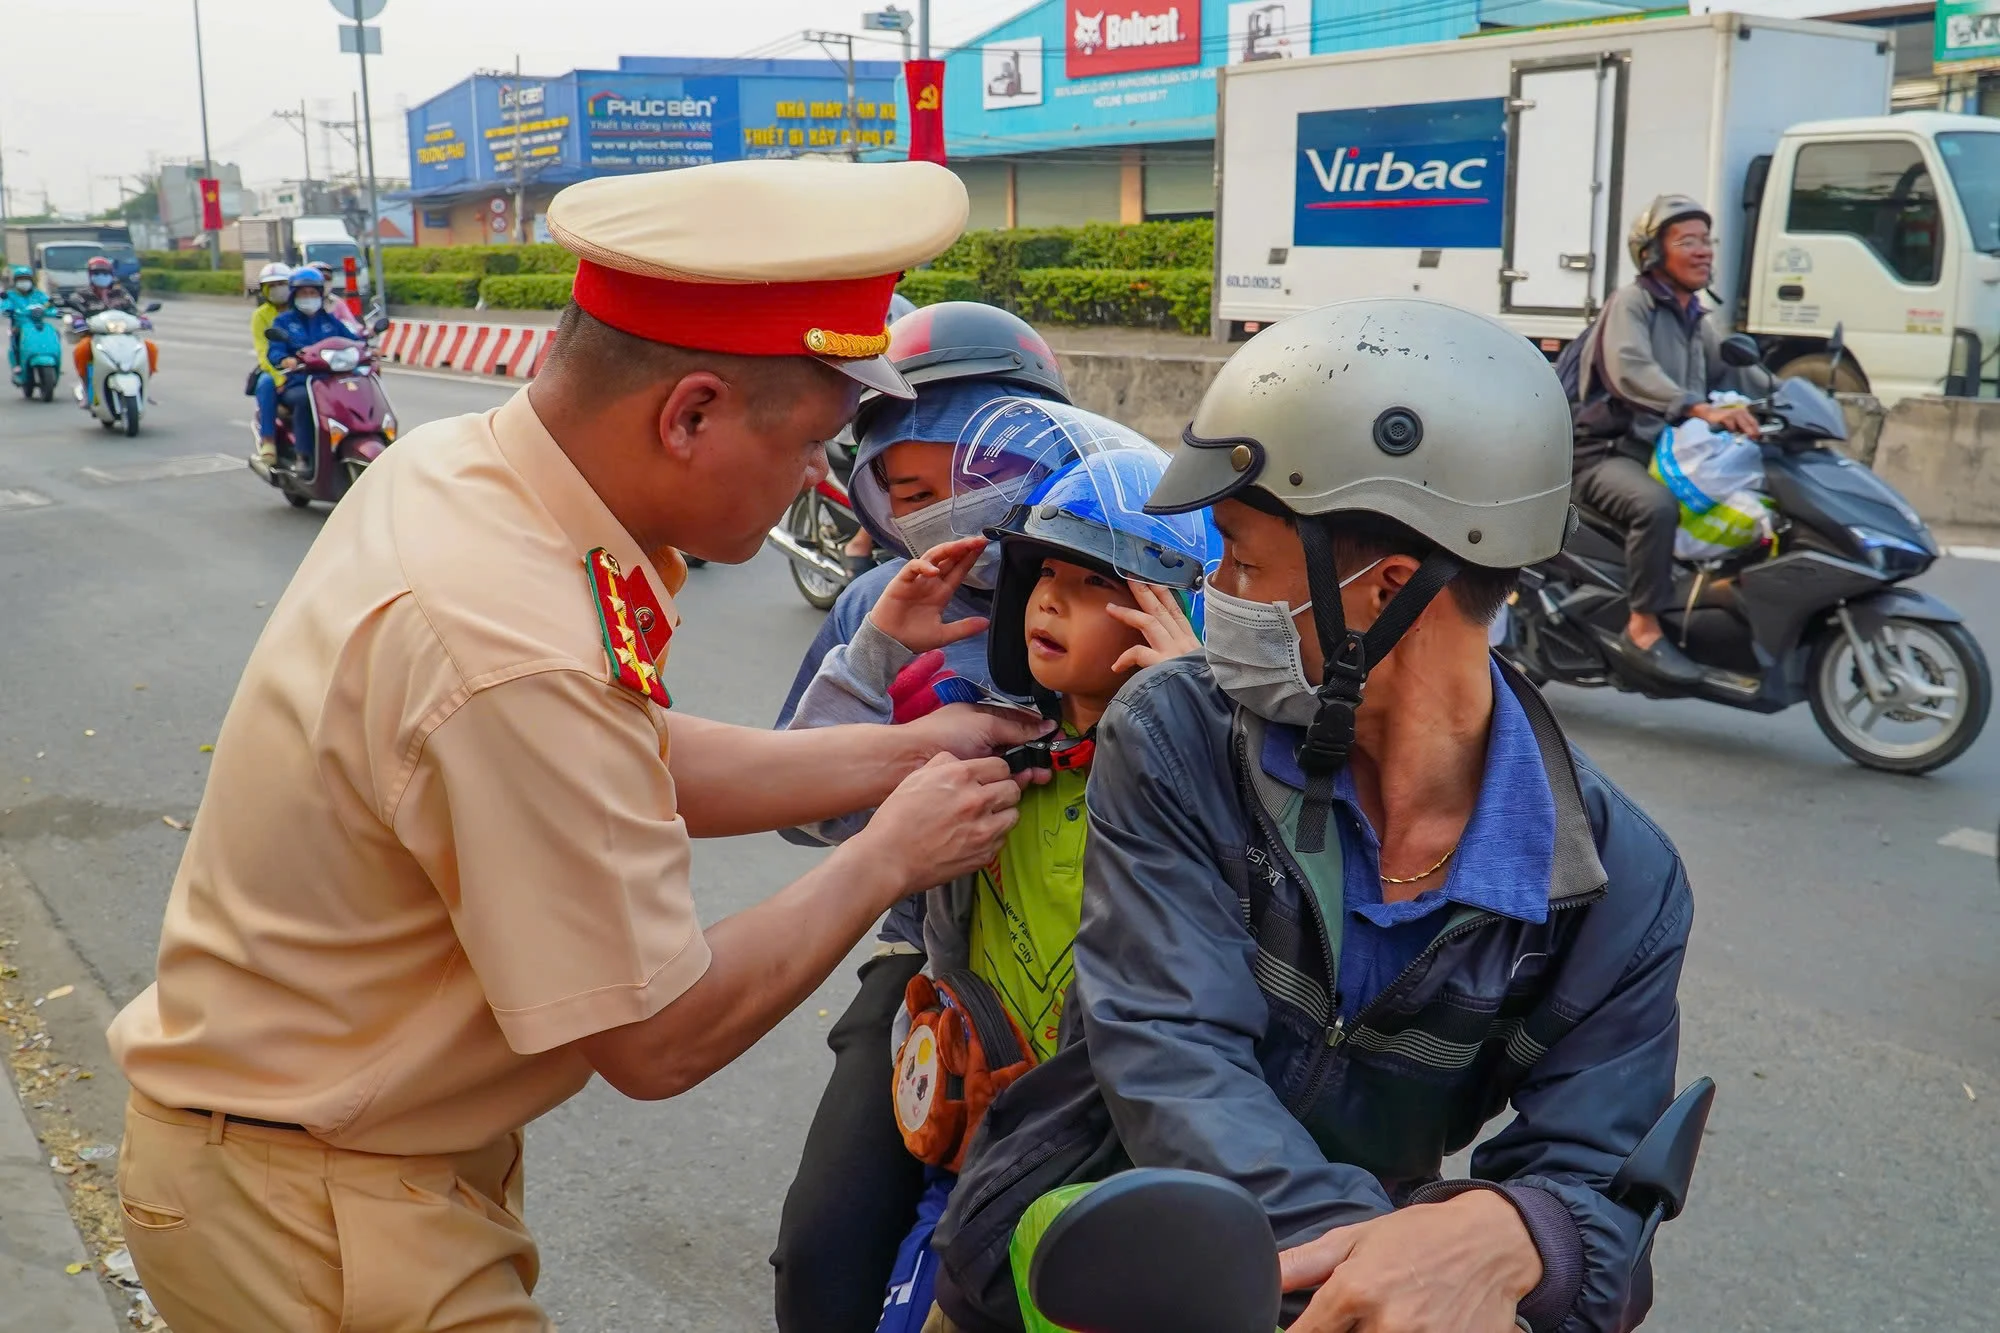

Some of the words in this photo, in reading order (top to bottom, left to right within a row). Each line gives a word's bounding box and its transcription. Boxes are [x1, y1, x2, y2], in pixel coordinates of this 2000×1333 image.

[1105, 7, 1179, 50] Bobcat
[1305, 147, 1487, 193] Virbac
[1018, 942, 1034, 964] City
